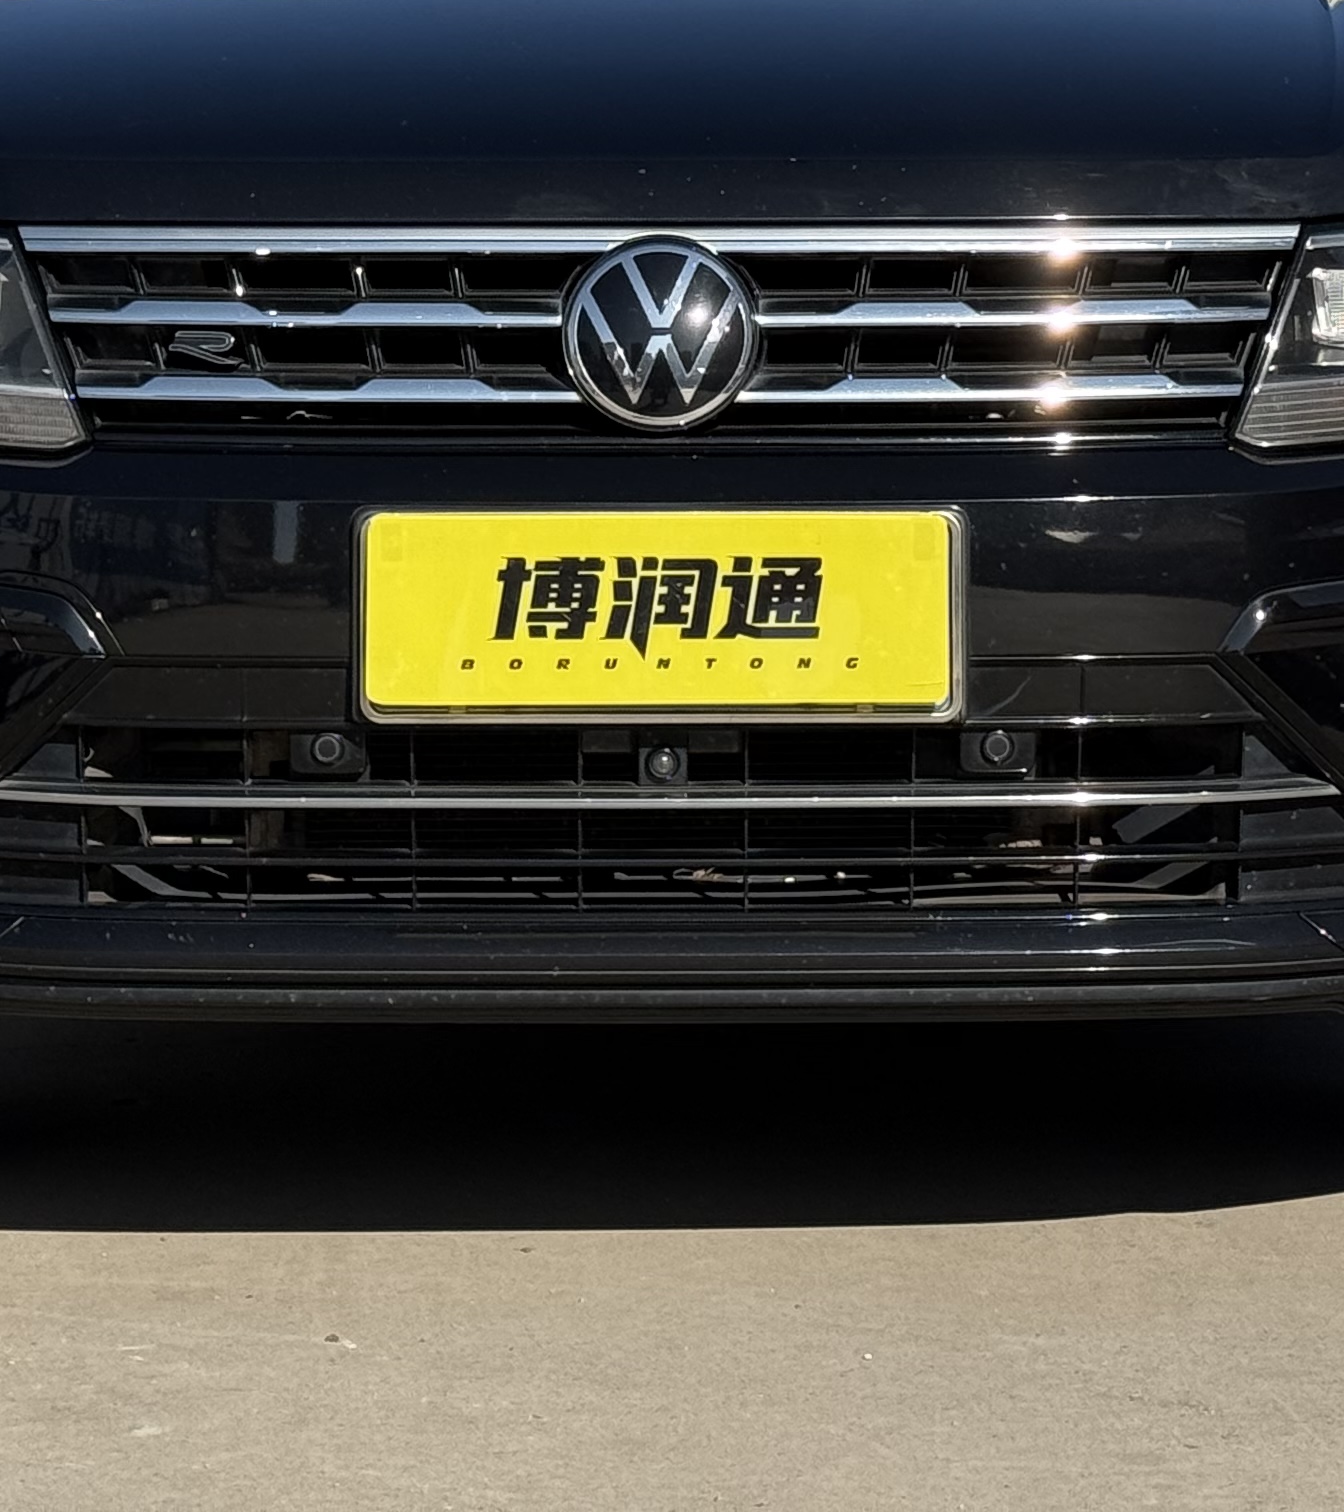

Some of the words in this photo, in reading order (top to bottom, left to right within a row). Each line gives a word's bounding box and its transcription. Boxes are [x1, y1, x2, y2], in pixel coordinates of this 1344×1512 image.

[488, 556, 824, 662] 博润通
[460, 657, 861, 671] BORUNTONG
